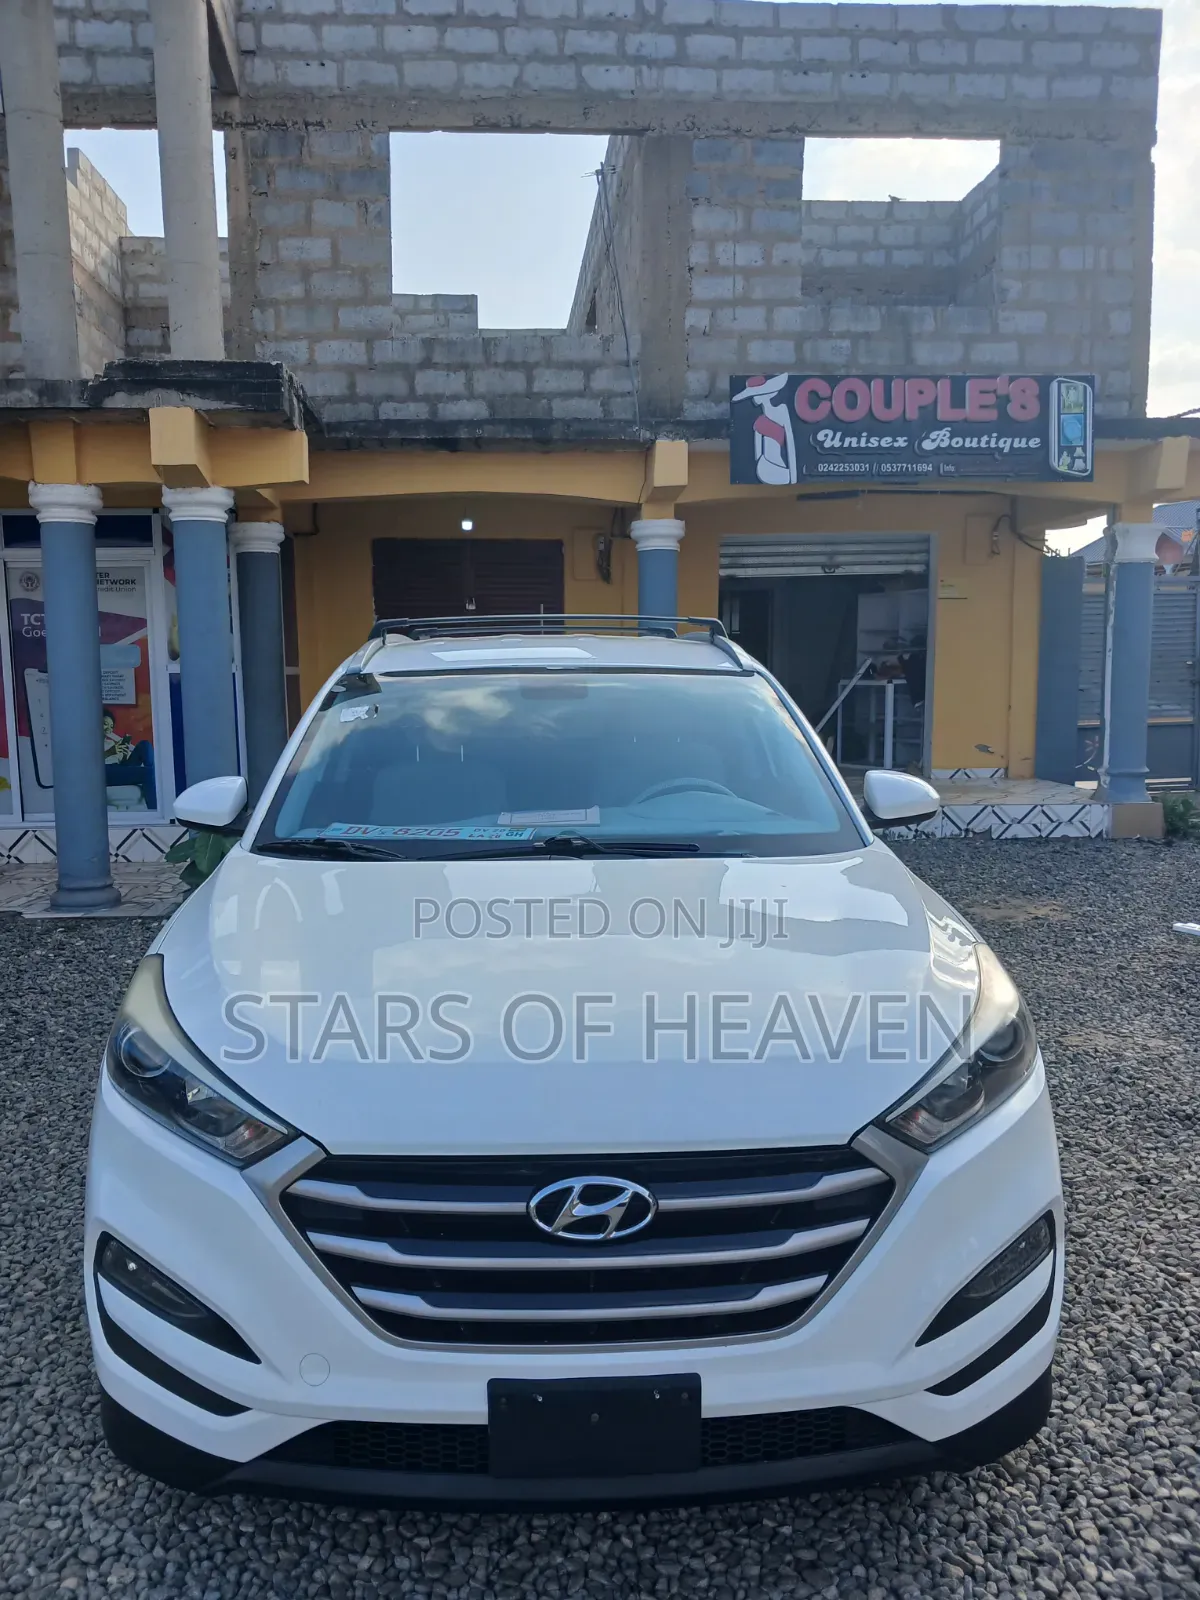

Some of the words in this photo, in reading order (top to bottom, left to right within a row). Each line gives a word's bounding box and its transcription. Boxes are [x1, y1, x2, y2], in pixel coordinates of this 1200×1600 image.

[795, 375, 1041, 422] COUPLE'S
[816, 429, 908, 449] Unisex
[921, 427, 1042, 453] Boutique
[817, 462, 870, 473] 0242253031
[880, 462, 933, 473] 0537711694
[340, 826, 380, 835] DV
